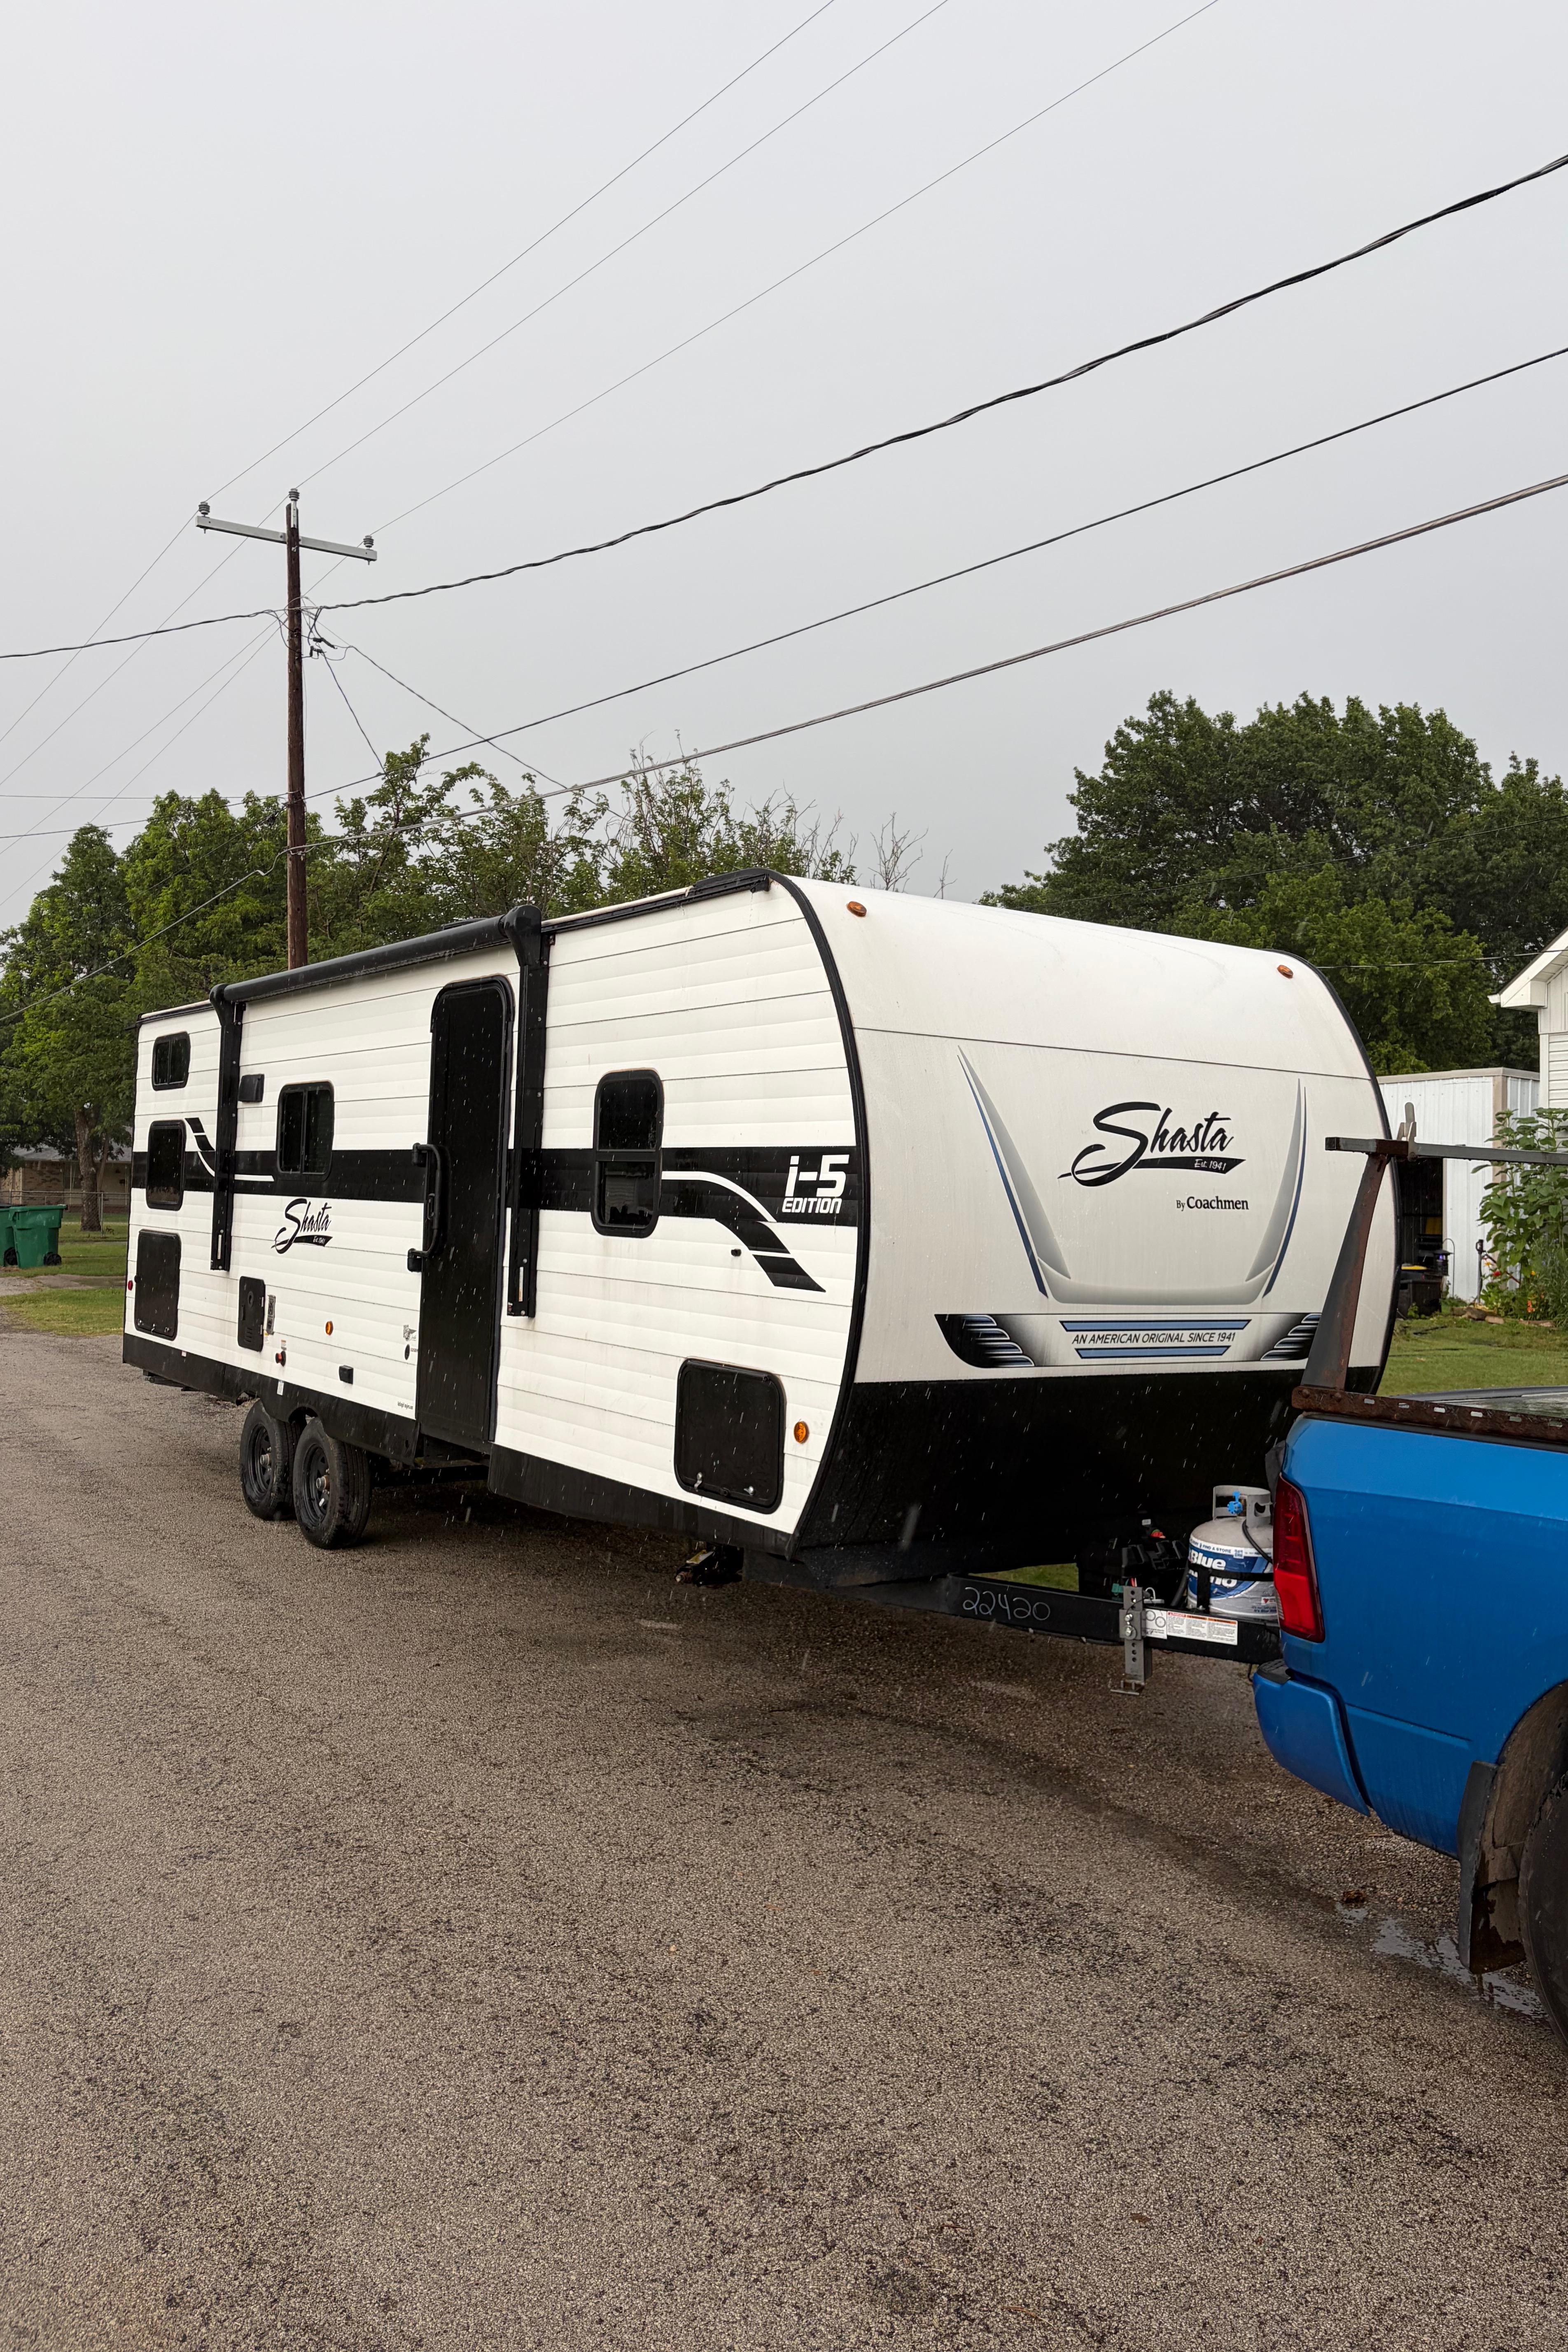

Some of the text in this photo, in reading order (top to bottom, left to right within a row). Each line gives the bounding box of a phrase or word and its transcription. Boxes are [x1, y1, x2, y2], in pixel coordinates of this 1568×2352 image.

[1071, 1101, 1234, 1187] Shasta
[784, 1154, 849, 1197] i-5
[1209, 1160, 1226, 1171] 1941
[782, 1198, 842, 1213] EDITION
[1176, 1196, 1249, 1211] By Coachmen
[275, 1198, 332, 1254] Shasta
[1072, 1332, 1235, 1344] AN AMERICAN ORIGINAL SINCE 1941
[1190, 1549, 1226, 1570] Blue
[963, 1587, 1051, 1621] 22420
